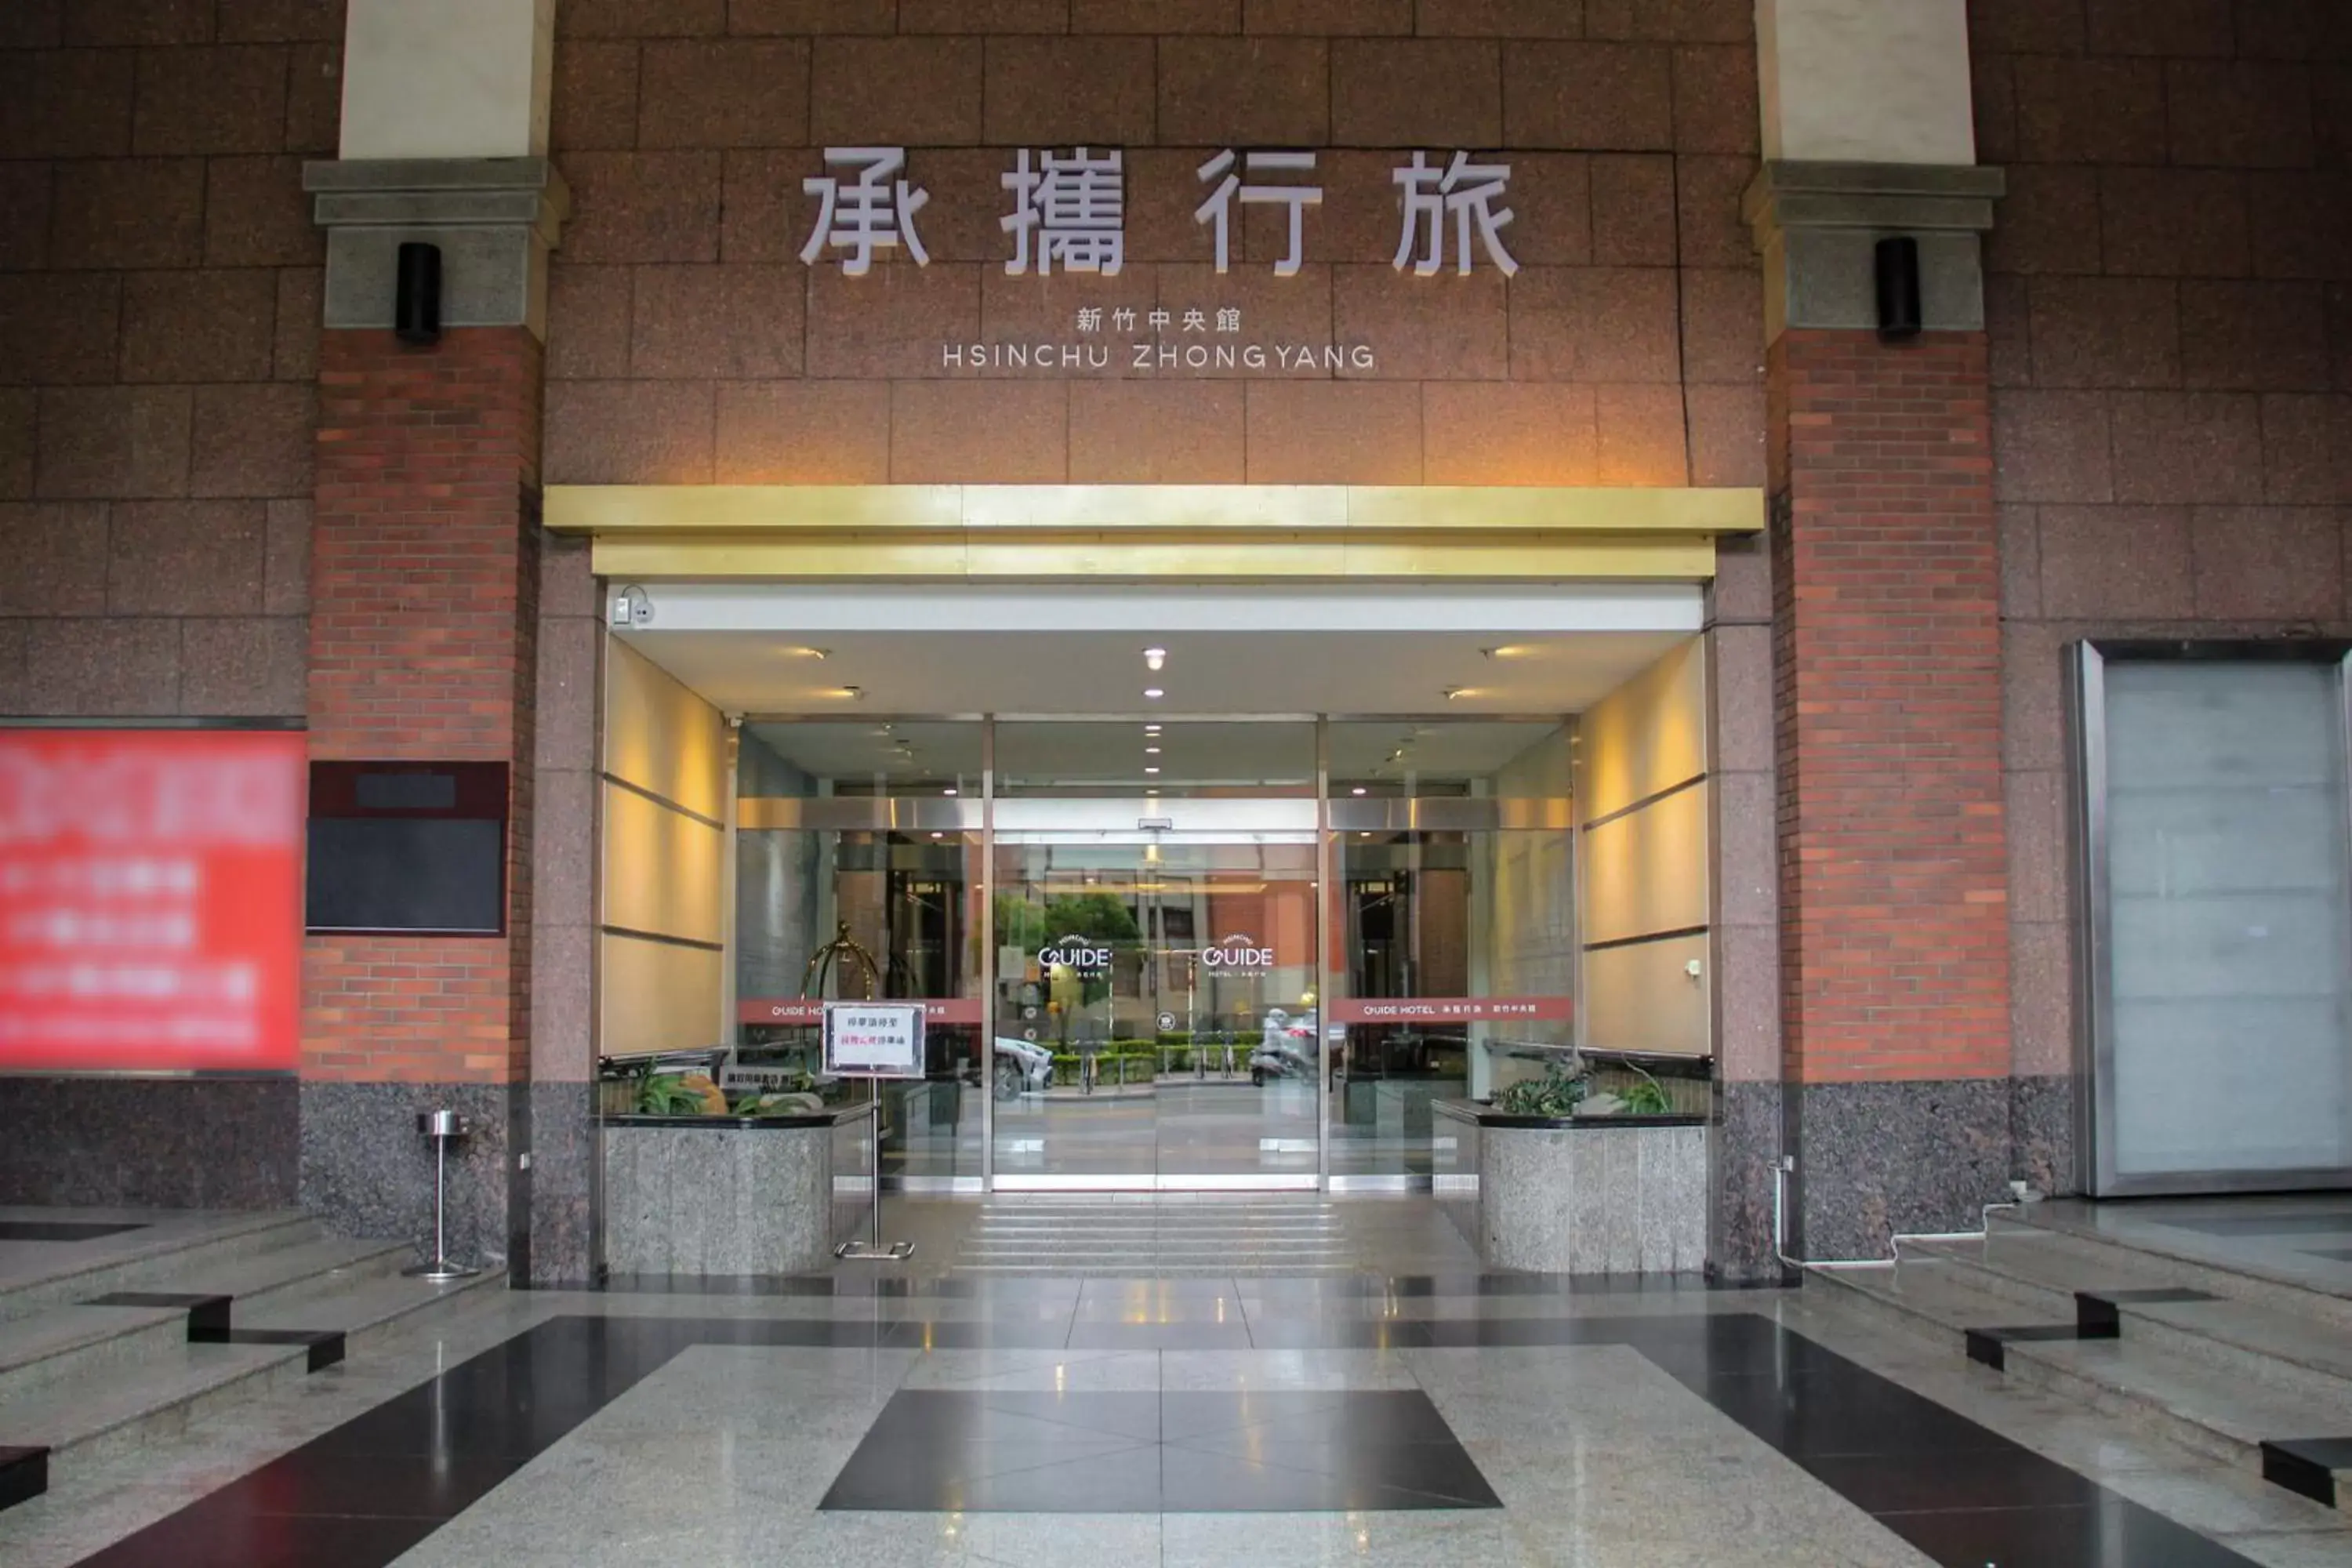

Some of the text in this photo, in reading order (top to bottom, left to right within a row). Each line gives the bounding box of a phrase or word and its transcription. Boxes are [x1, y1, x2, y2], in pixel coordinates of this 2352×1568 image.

[798, 146, 1519, 278] 承攜行旅
[1076, 307, 1243, 333] 新竹中央館
[942, 344, 1376, 369] HSINCHU ZHONGYANG
[1038, 946, 1109, 967] GUIDE
[1202, 946, 1274, 966] GUIDE
[1400, 1005, 1436, 1014] HOTEL
